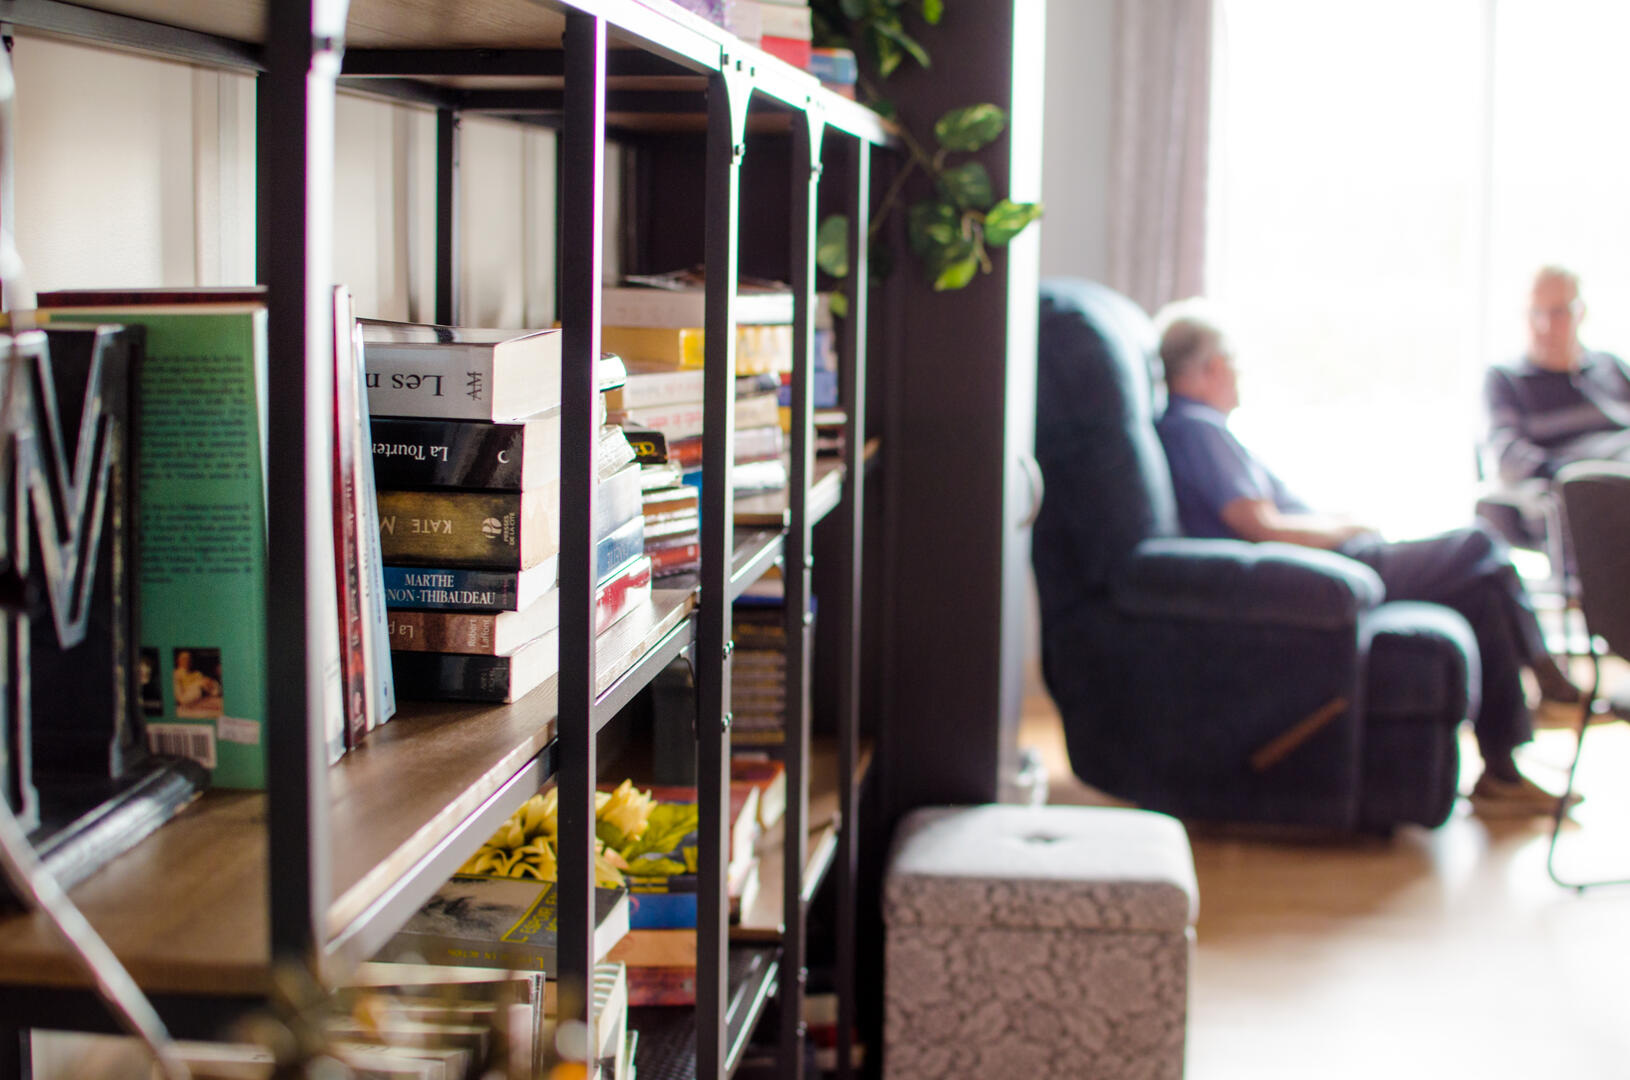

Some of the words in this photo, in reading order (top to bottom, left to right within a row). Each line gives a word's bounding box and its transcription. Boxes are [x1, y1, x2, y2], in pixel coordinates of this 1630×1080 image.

[391, 373, 444, 397] Les
[429, 445, 449, 462] La
[410, 518, 453, 534] KATE
[404, 573, 455, 588] MARTHE
[399, 625, 414, 639] La
[467, 618, 478, 647] Robert
